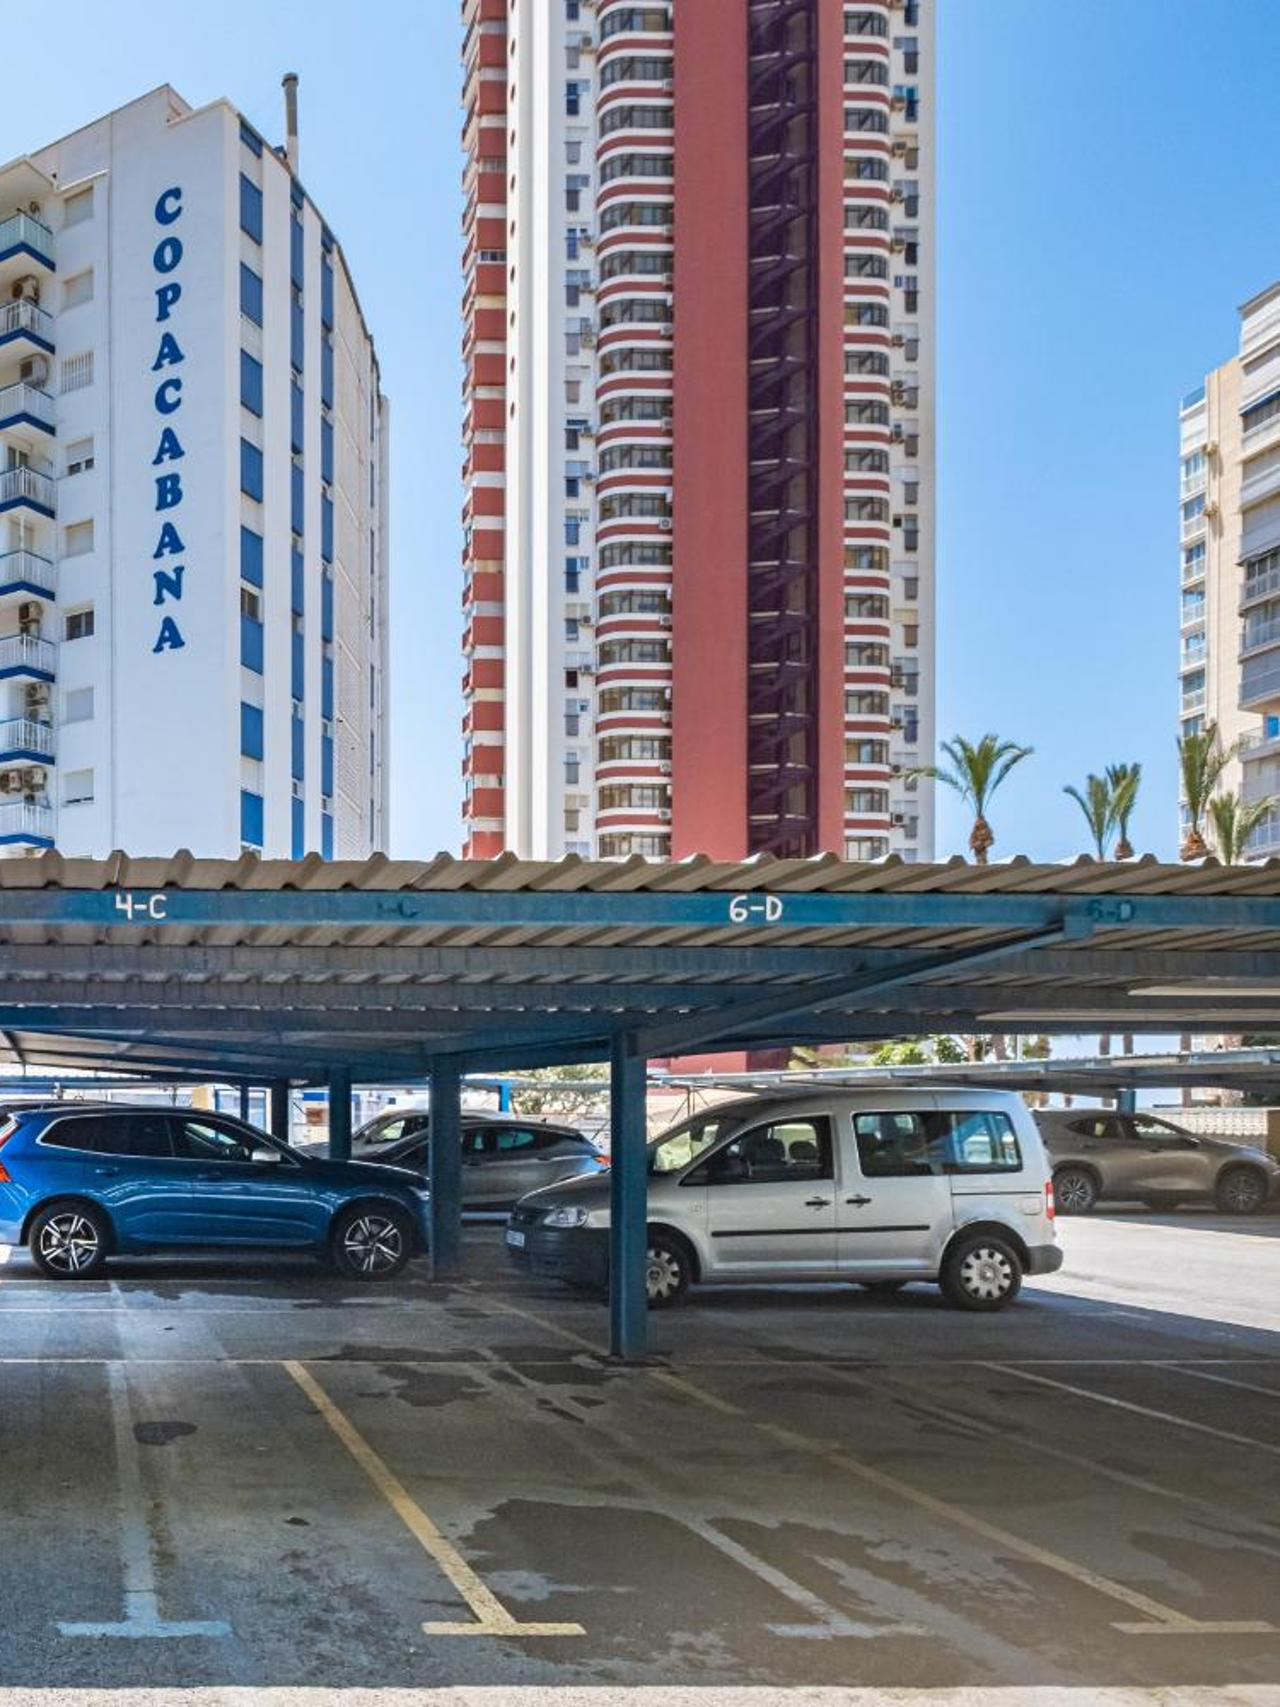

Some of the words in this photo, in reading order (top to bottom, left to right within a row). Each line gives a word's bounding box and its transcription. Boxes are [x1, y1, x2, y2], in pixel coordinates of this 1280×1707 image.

[152, 186, 185, 654] COPACABANA
[115, 894, 167, 919] 4-C
[729, 895, 783, 922] 6-D
